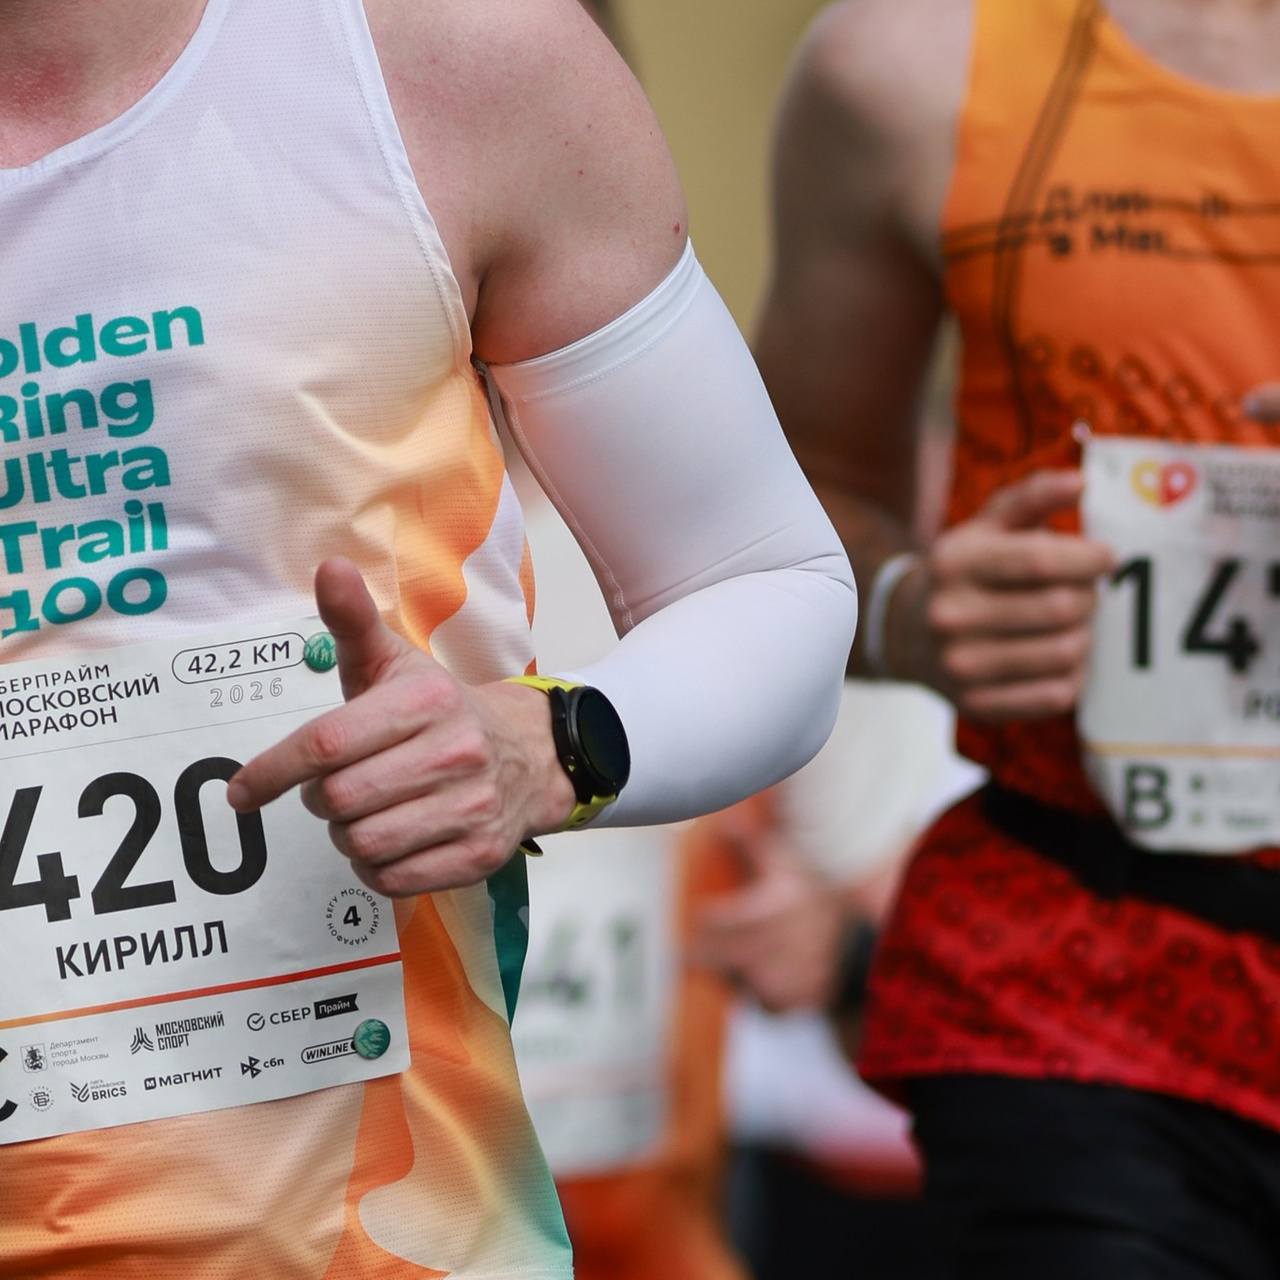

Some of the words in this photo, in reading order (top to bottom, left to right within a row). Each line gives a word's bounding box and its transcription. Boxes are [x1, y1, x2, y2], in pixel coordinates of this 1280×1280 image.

[1109, 555, 1280, 675] 14
[187, 649, 242, 676] 42,2
[253, 640, 291, 665] КМ
[209, 677, 284, 708] 2026
[343, 905, 362, 927] 4
[55, 920, 230, 980] КИРИЛЛ
[155, 1011, 225, 1037] МОСКОВСКИЙ
[269, 1007, 312, 1025] СБЕР
[319, 999, 351, 1015] Прайм
[158, 1033, 190, 1051] СПОРТ
[306, 1041, 350, 1062] WINLINE
[91, 1086, 127, 1101] BRICS
